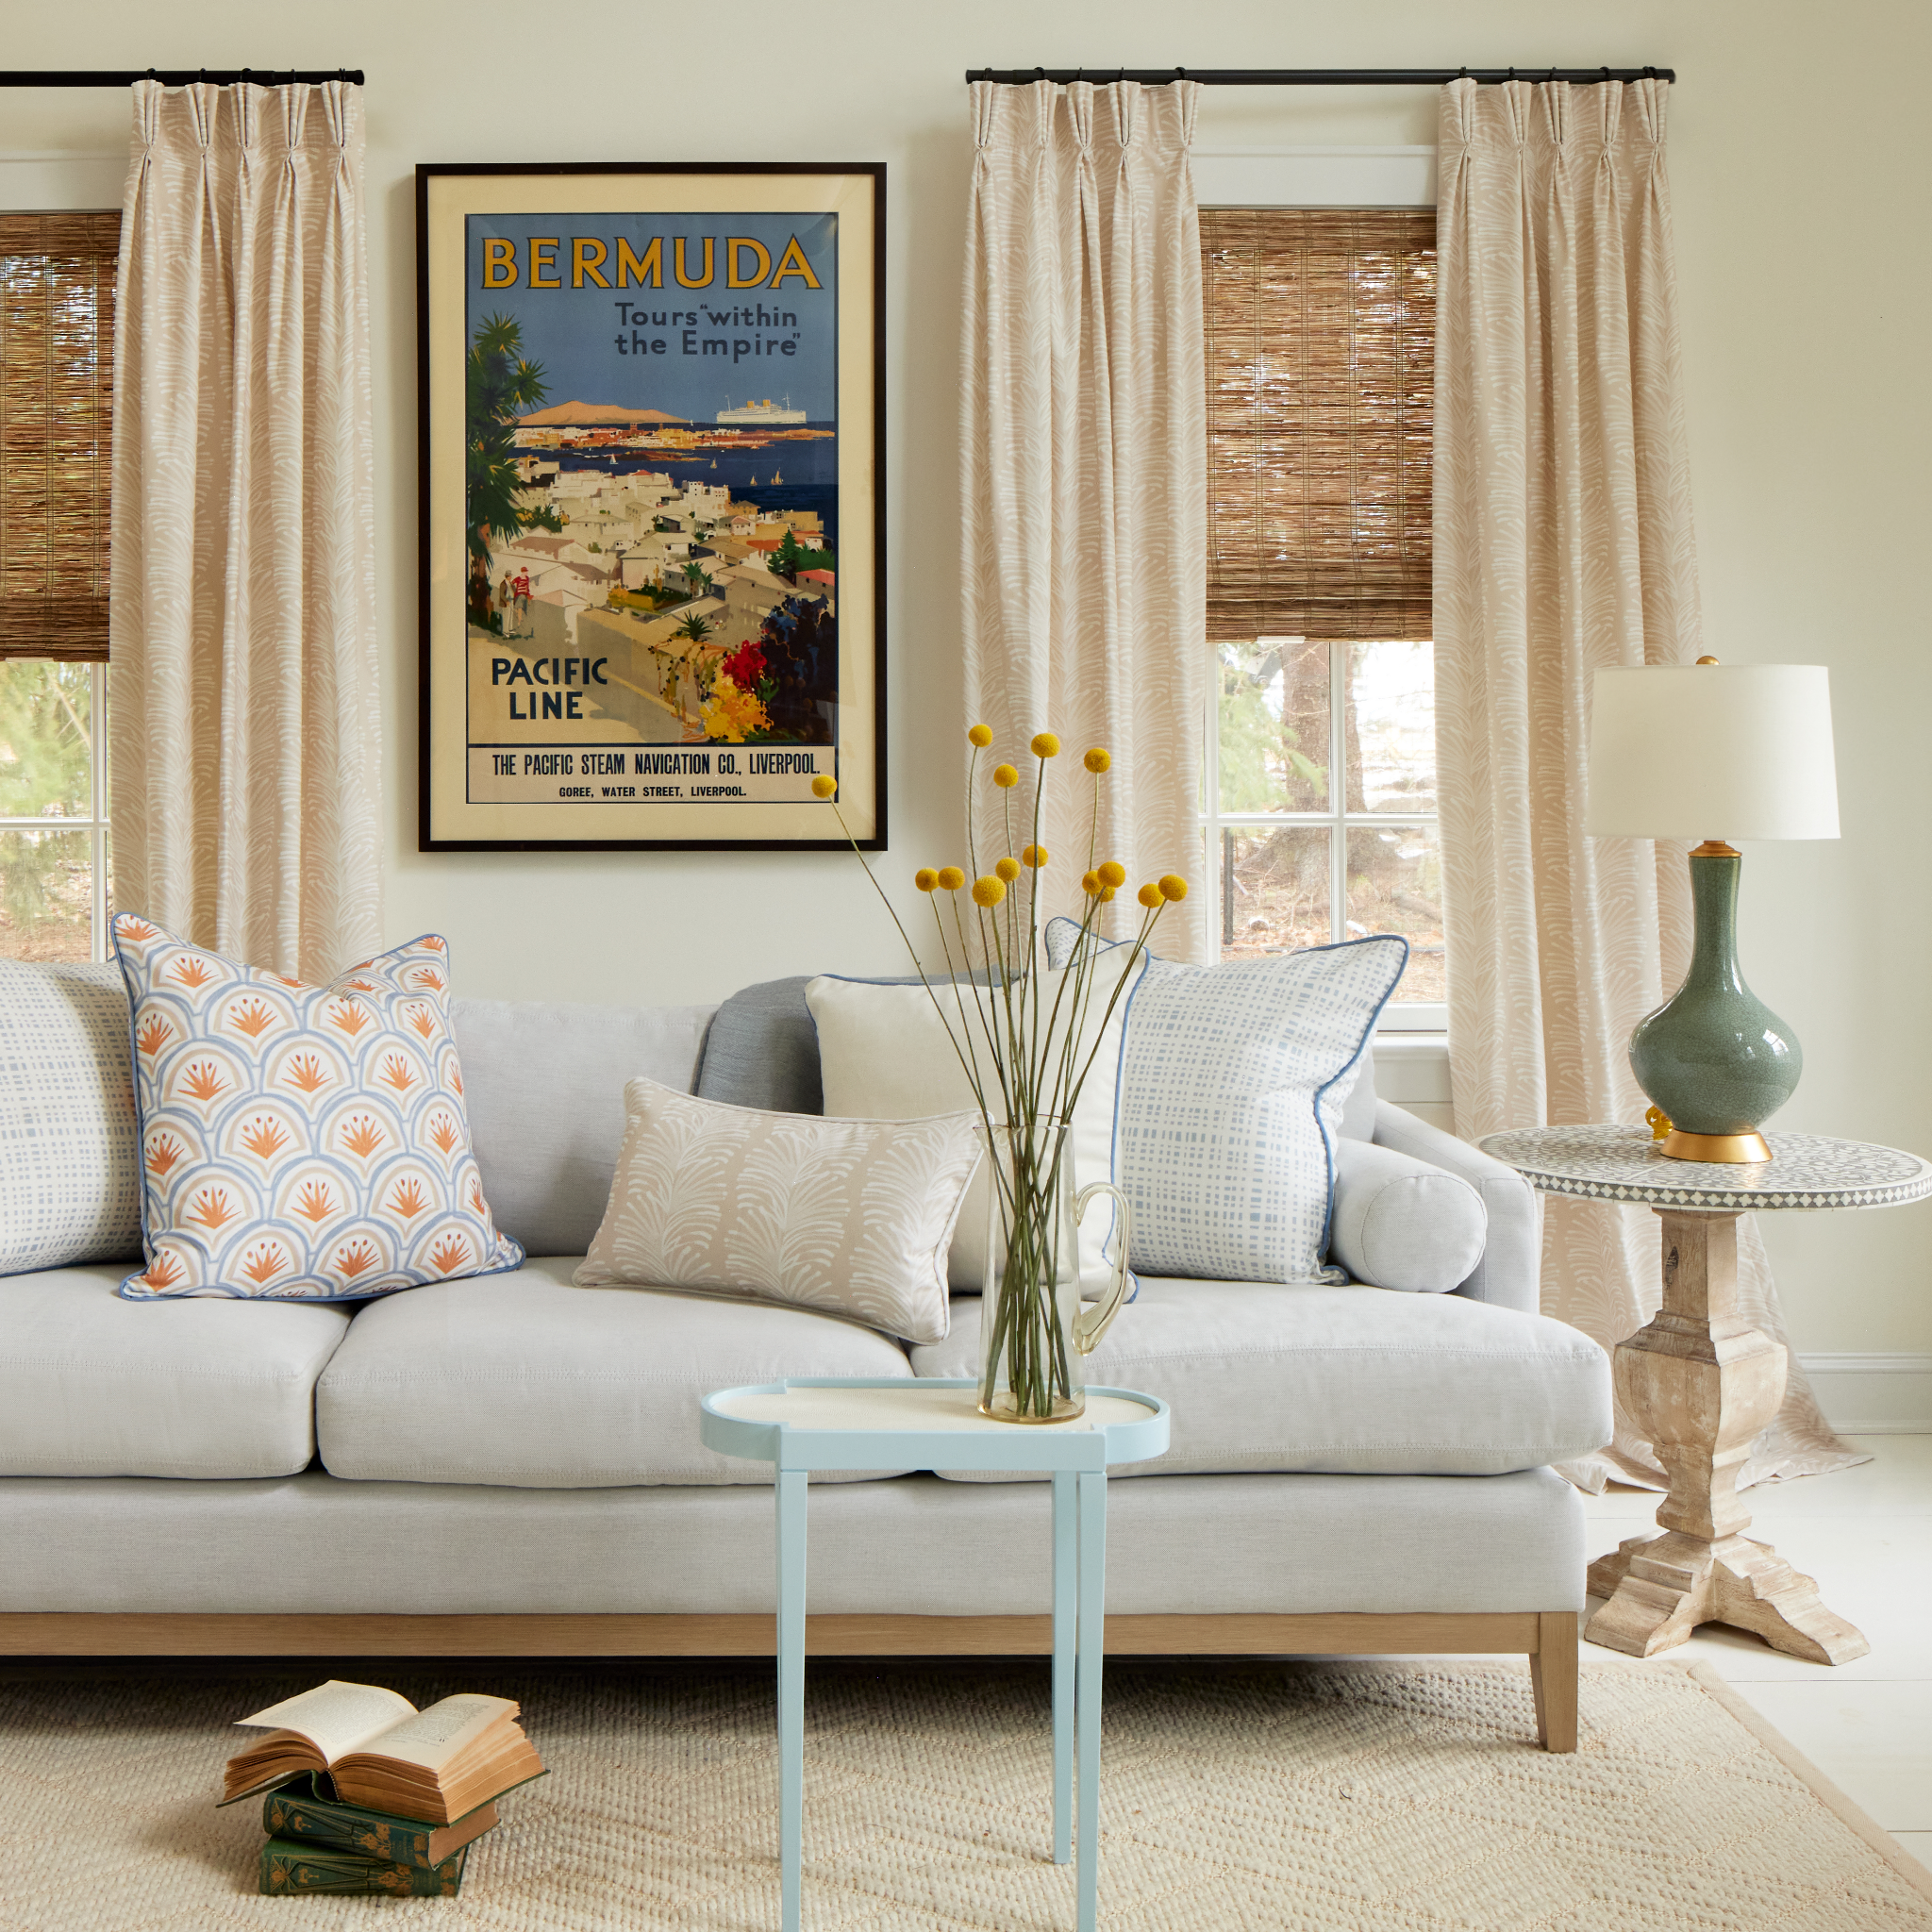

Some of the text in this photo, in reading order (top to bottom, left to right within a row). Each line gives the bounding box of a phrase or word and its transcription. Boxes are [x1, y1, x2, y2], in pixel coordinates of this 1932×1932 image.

[481, 233, 824, 290] BERMUDA
[614, 302, 697, 326] Tours
[614, 330, 666, 355] the
[491, 658, 608, 685] PACIFIC
[508, 691, 583, 720] LINE
[492, 753, 820, 775] THE PACIFIC STEAM NAVIGATION CO., LIVERPOOL.
[558, 786, 747, 798] GOREE, WATER STREET, LIVERPOOL.
